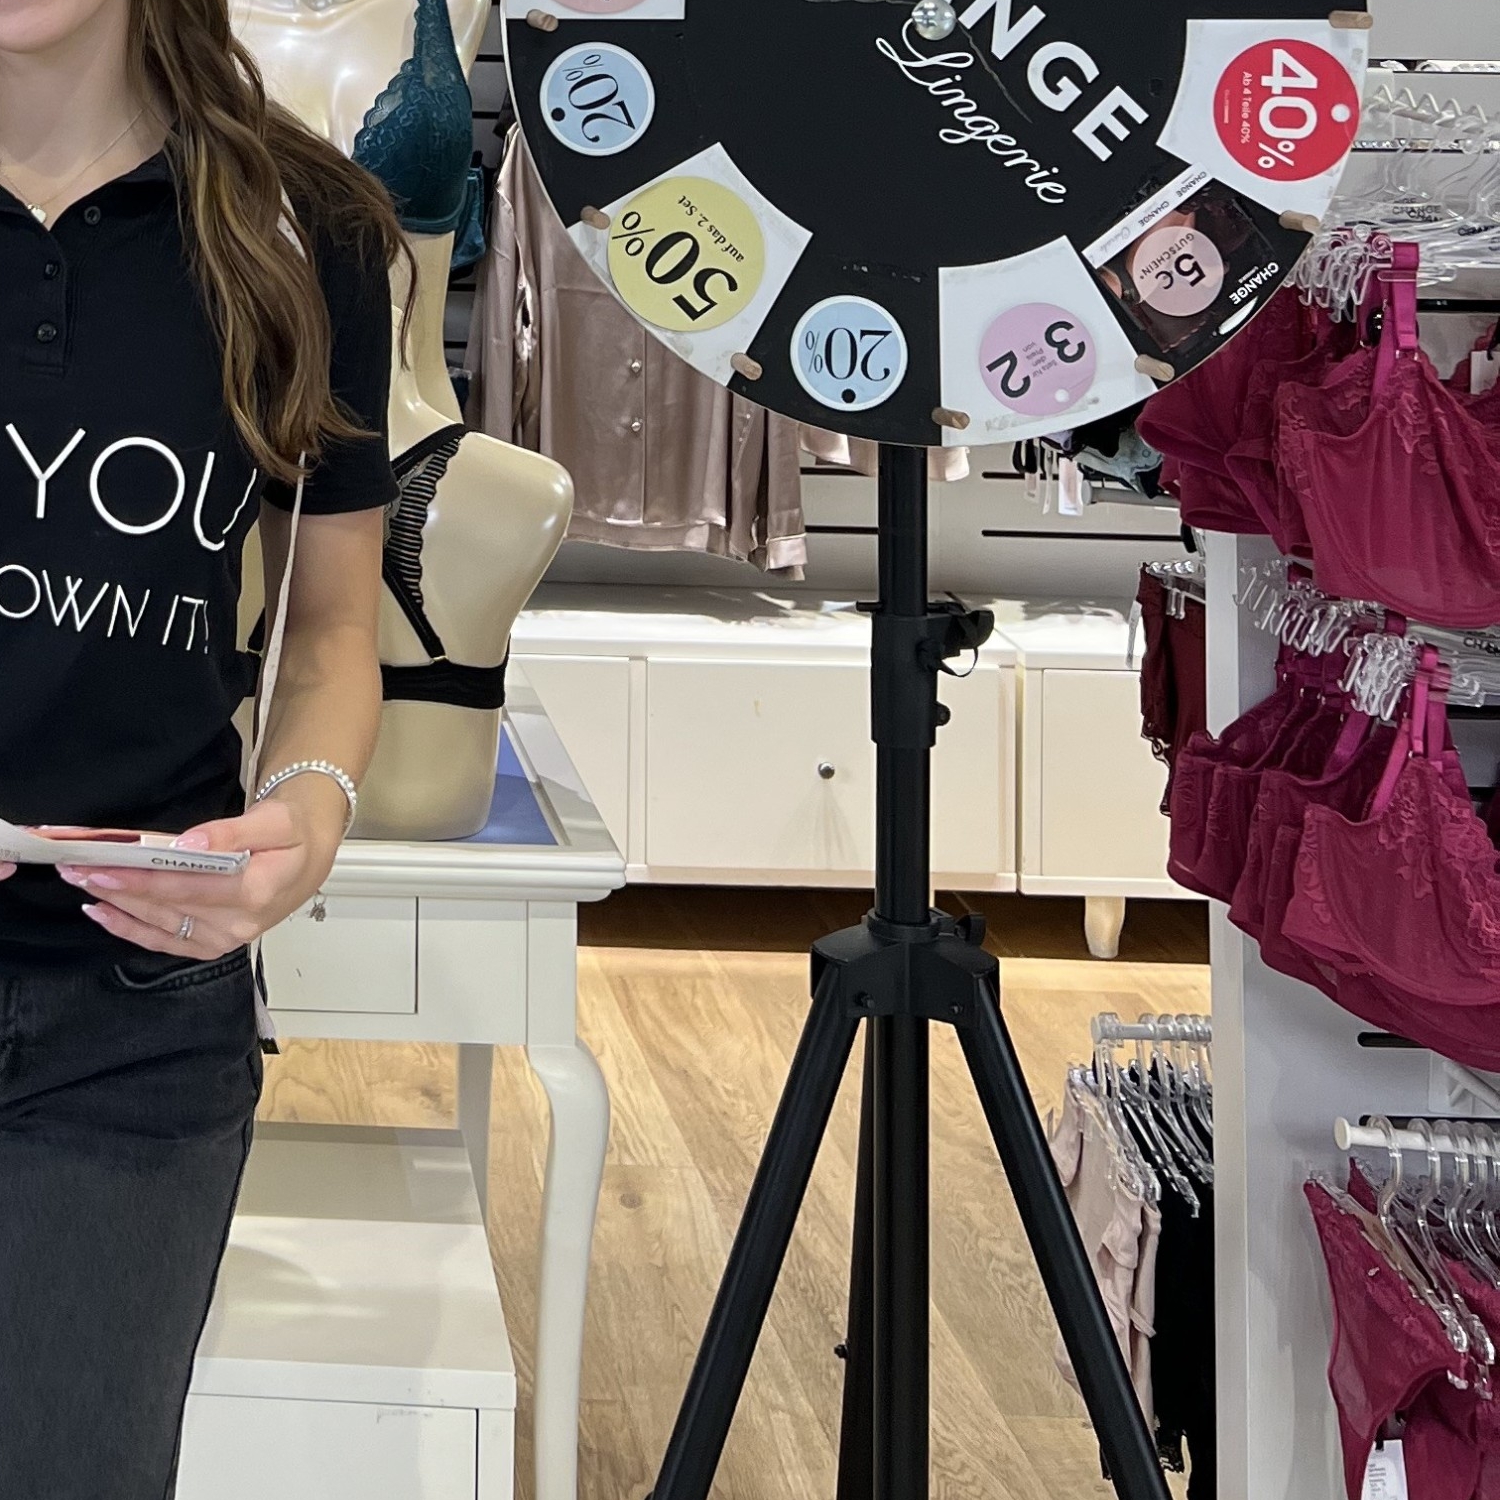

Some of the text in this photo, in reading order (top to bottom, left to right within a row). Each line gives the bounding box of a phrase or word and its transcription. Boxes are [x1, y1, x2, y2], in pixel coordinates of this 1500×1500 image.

[562, 54, 636, 143] 20%
[1242, 71, 1252, 86] Ab
[876, 17, 1067, 204] Lingerie
[1240, 122, 1250, 144] 40%
[1241, 97, 1251, 121] Teile
[1257, 48, 1318, 169] 40%
[677, 196, 745, 263] auf das 2. Set
[608, 211, 738, 322] 50%
[1229, 262, 1280, 305] CHANGE
[805, 327, 892, 381] 20%
[1044, 320, 1086, 363] 3
[985, 350, 1031, 398] 2
[5, 422, 257, 551] YOU
[162, 594, 210, 654] IT!
